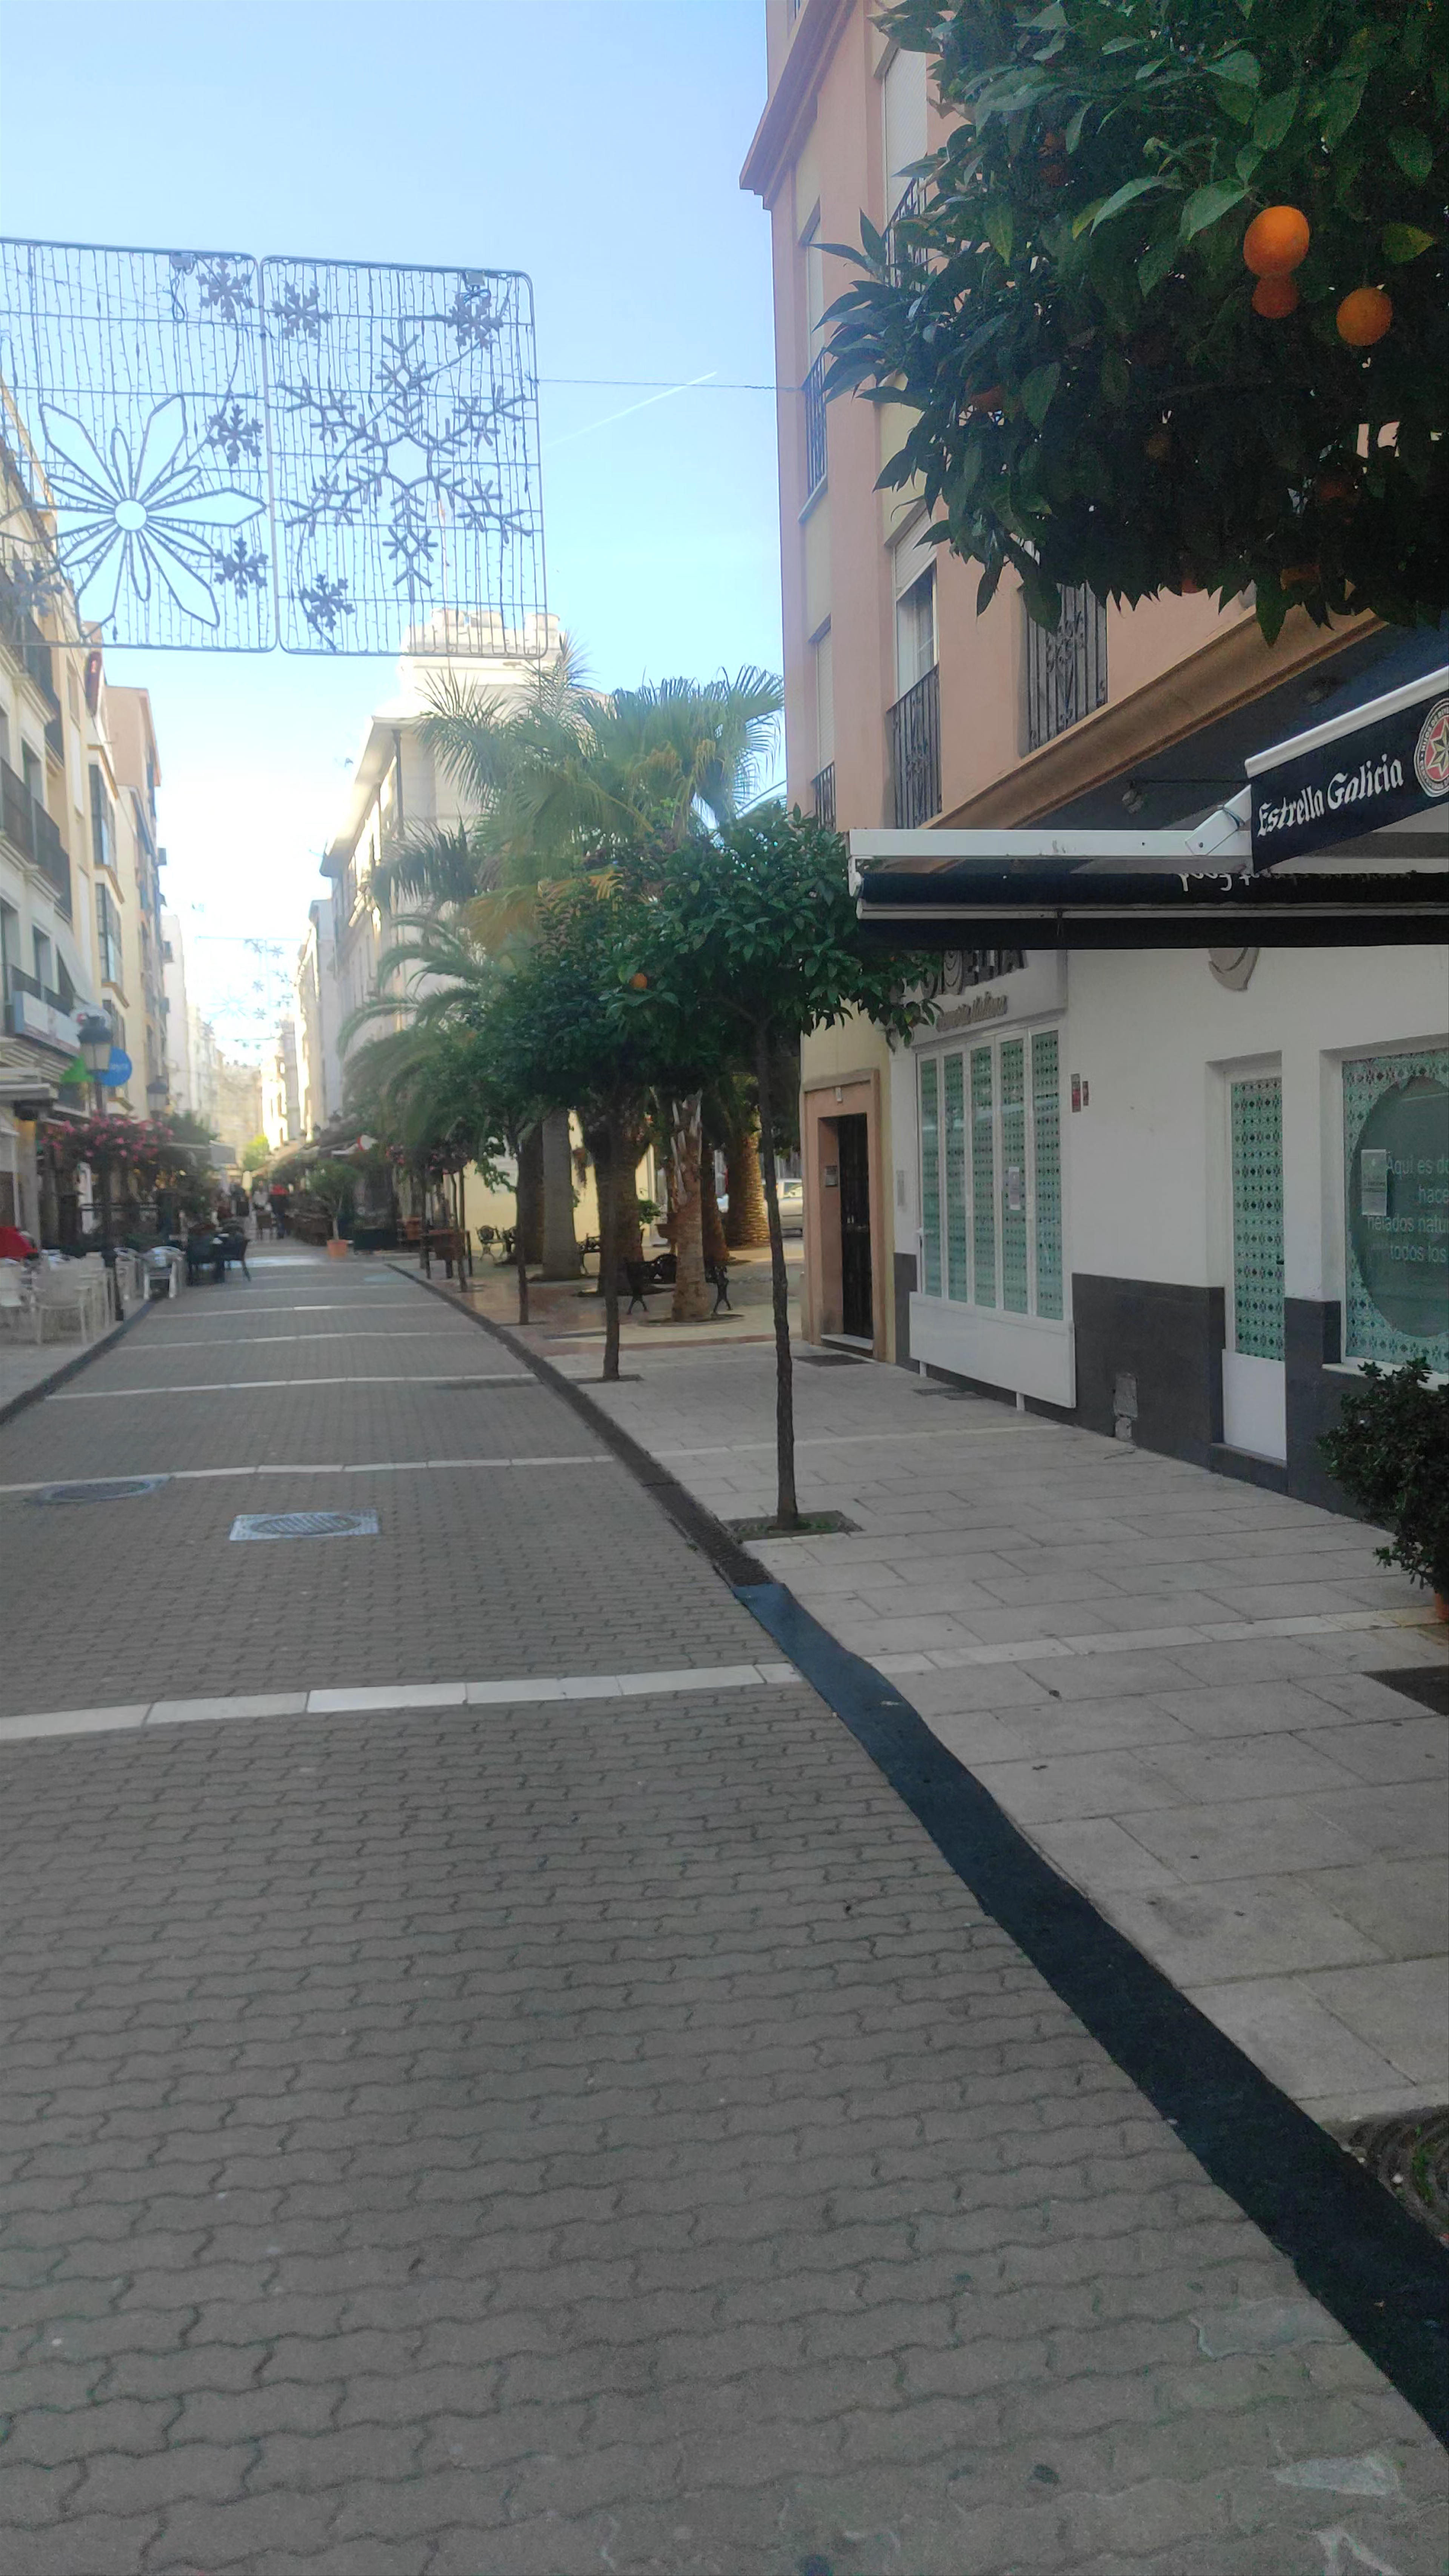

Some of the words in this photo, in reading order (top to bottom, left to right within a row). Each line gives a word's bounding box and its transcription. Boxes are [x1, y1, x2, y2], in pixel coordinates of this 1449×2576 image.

[1257, 786, 1324, 837] Estrella
[1327, 754, 1404, 810] Galicia
[1417, 1159, 1433, 1175] es
